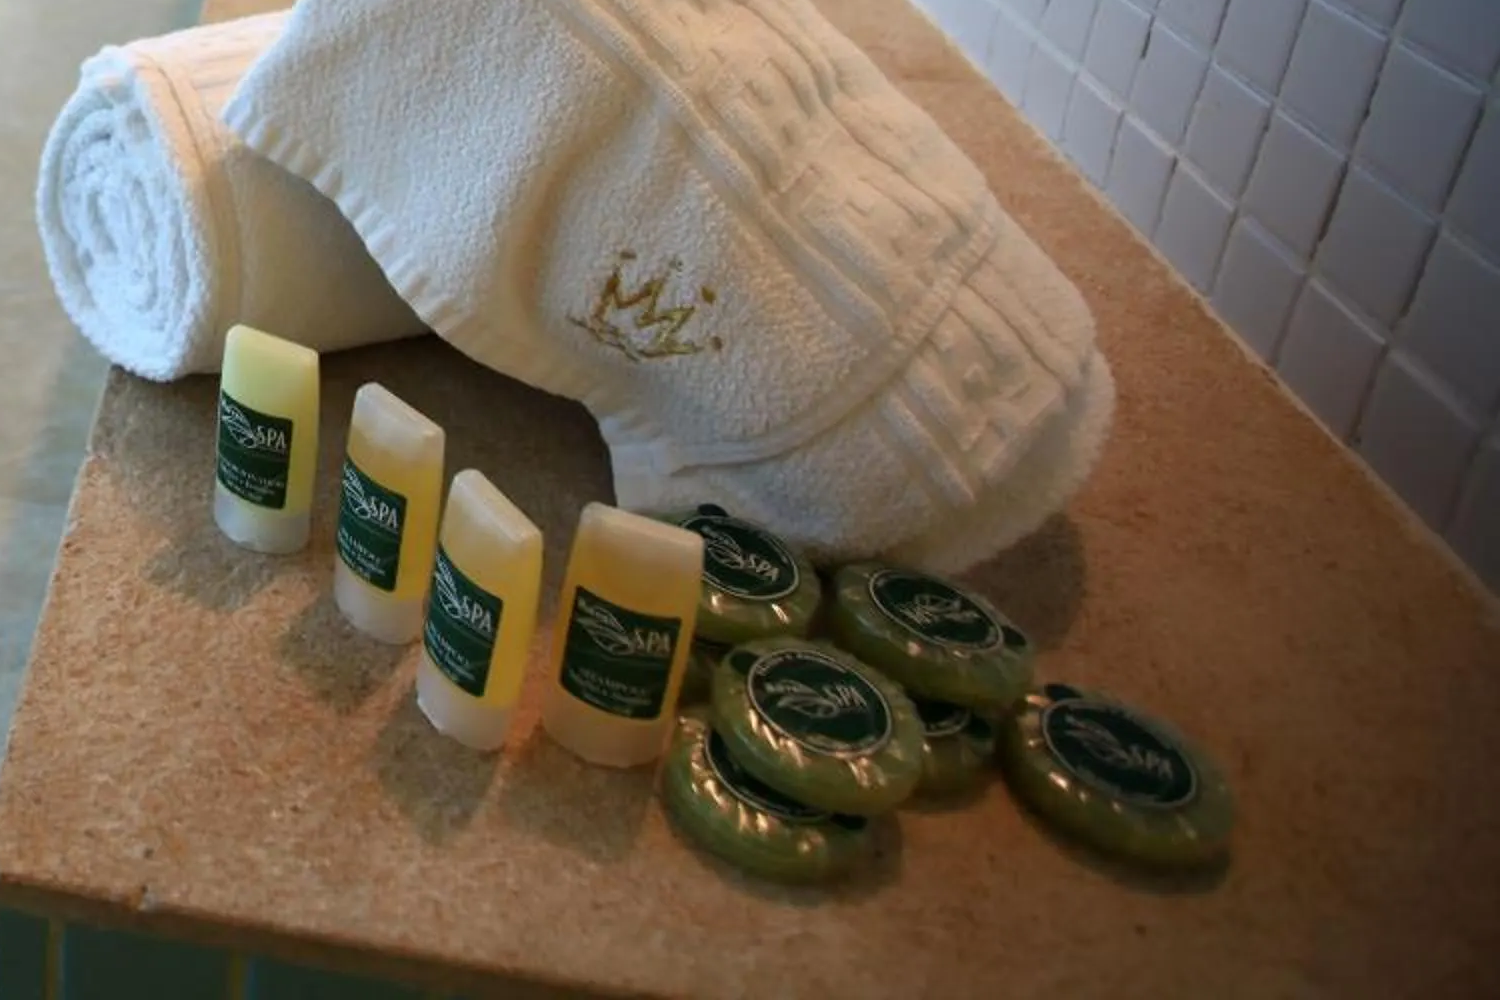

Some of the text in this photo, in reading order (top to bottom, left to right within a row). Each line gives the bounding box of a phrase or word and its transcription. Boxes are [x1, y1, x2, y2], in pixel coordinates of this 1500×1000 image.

[255, 424, 286, 450] SPA
[369, 496, 398, 529] SPA
[748, 554, 780, 582] SPA
[461, 595, 492, 632] SPA
[632, 627, 671, 653] SPA
[821, 683, 868, 708] SPA
